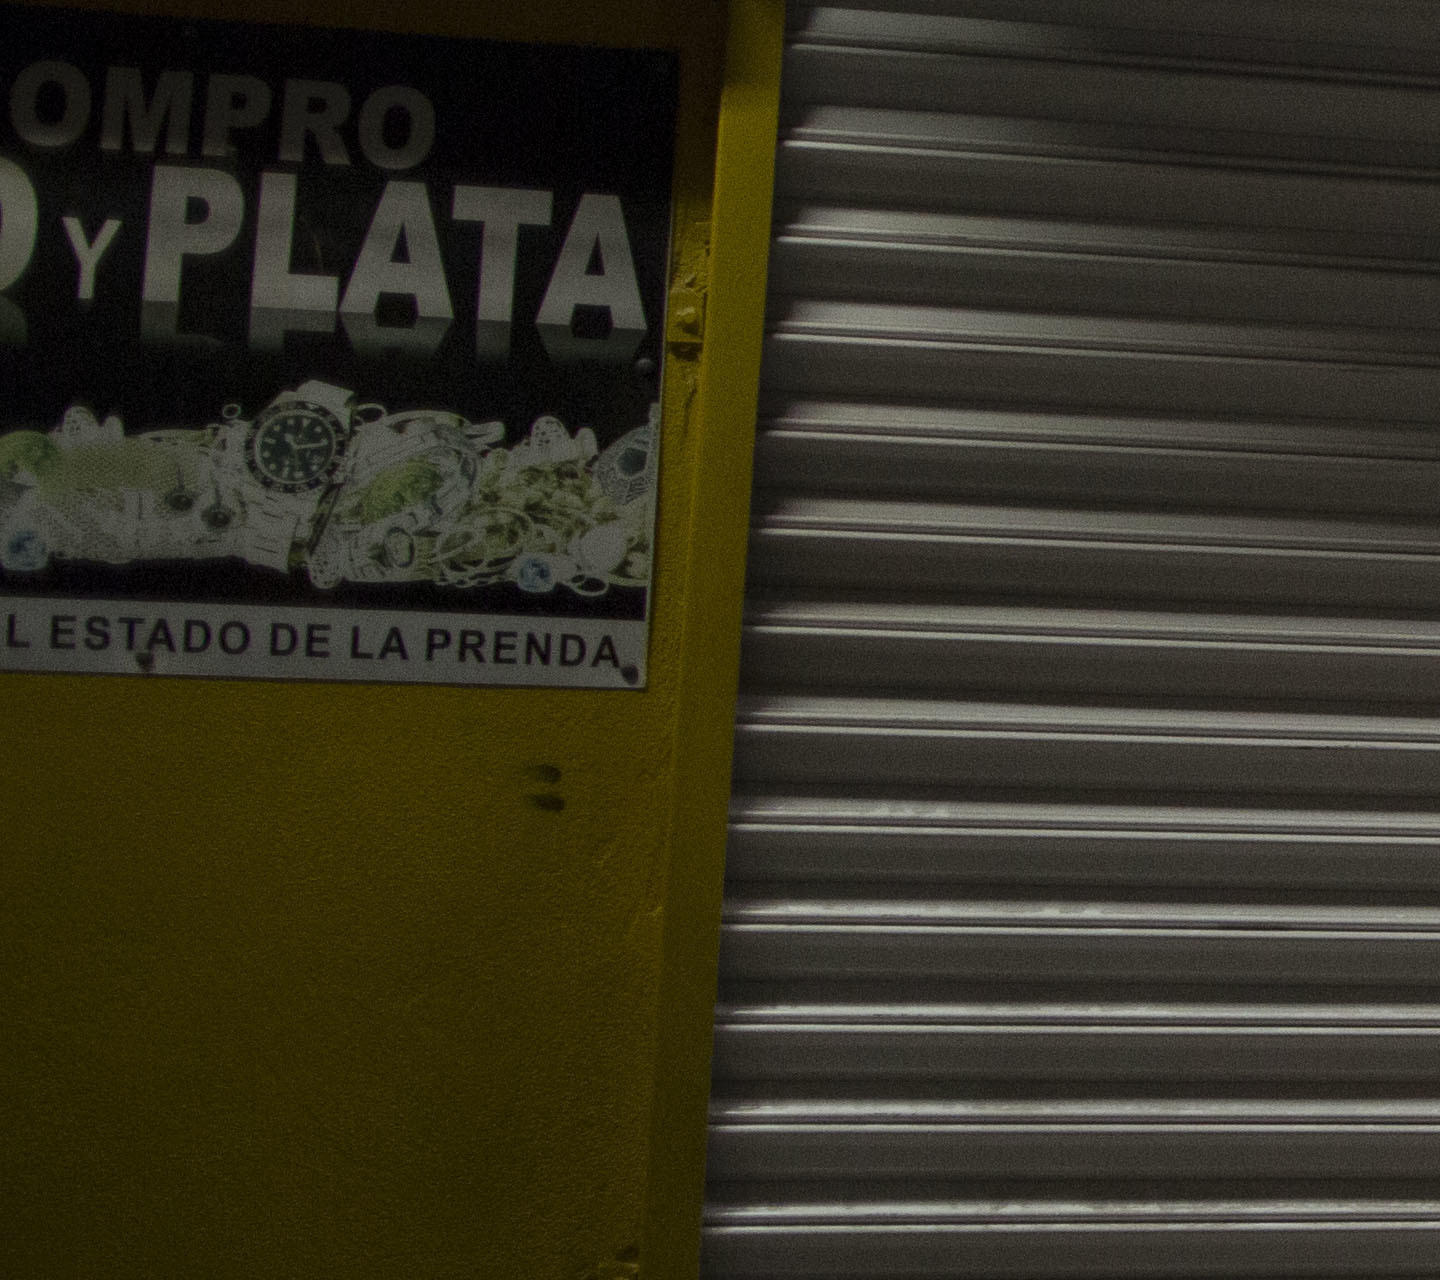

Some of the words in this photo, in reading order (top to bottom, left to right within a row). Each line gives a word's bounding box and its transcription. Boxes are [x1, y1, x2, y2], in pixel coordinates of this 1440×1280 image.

[8, 58, 437, 170] OMPRO
[140, 165, 648, 330] PLATA
[50, 615, 253, 657] ESTADO
[271, 623, 332, 659] DE
[351, 624, 410, 662] LA
[426, 627, 622, 669] PRENDA
